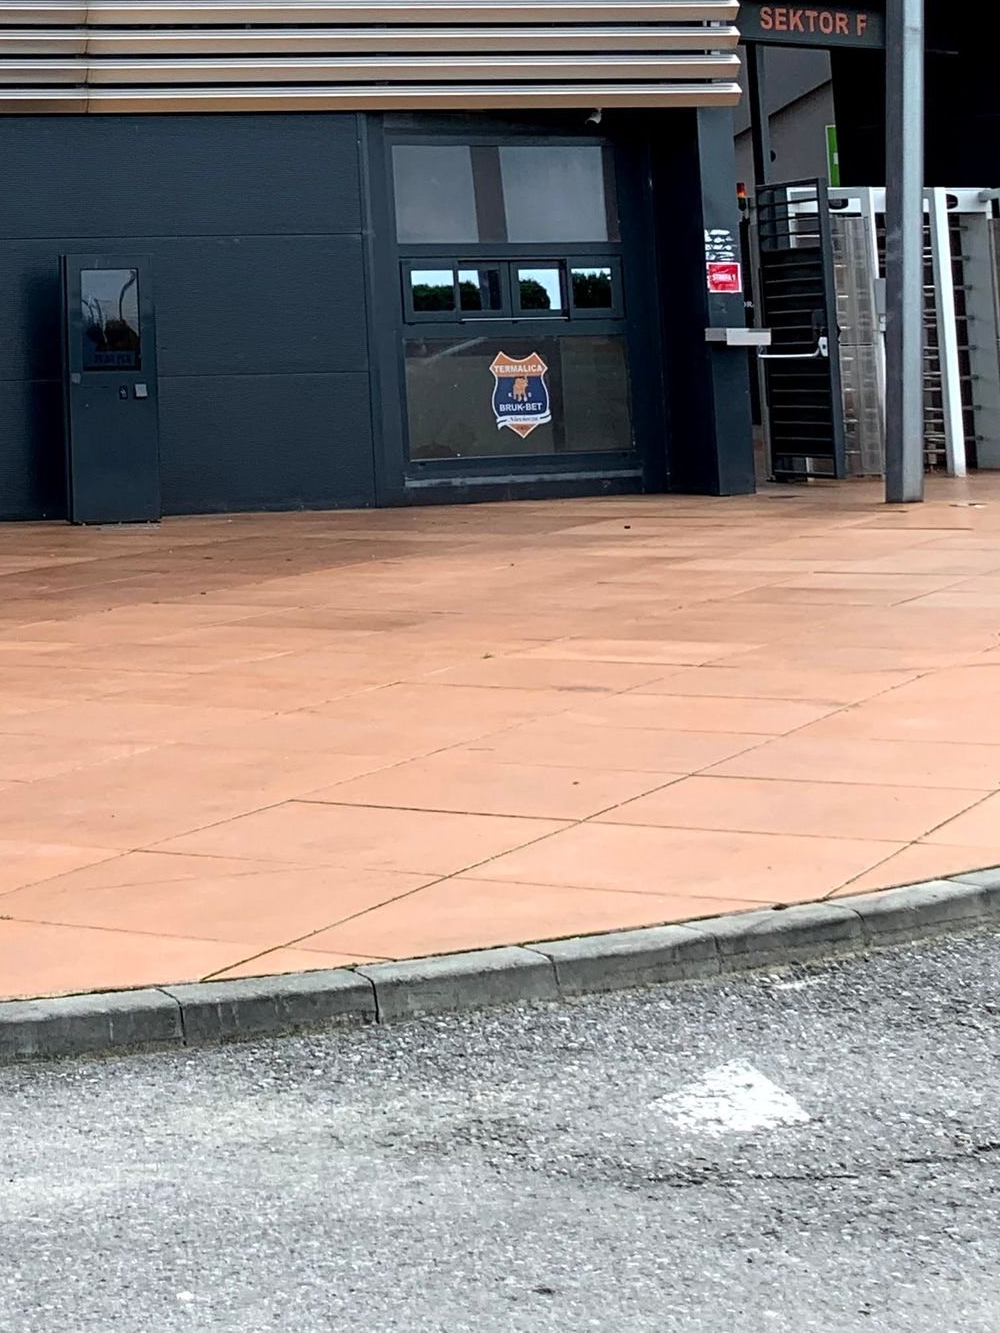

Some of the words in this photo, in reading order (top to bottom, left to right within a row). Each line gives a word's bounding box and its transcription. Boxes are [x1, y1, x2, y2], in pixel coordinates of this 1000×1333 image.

[760, 6, 849, 35] SEKTOR
[856, 13, 867, 36] F
[493, 365, 543, 373] TERMALICA
[499, 402, 543, 412] BRUK-BET
